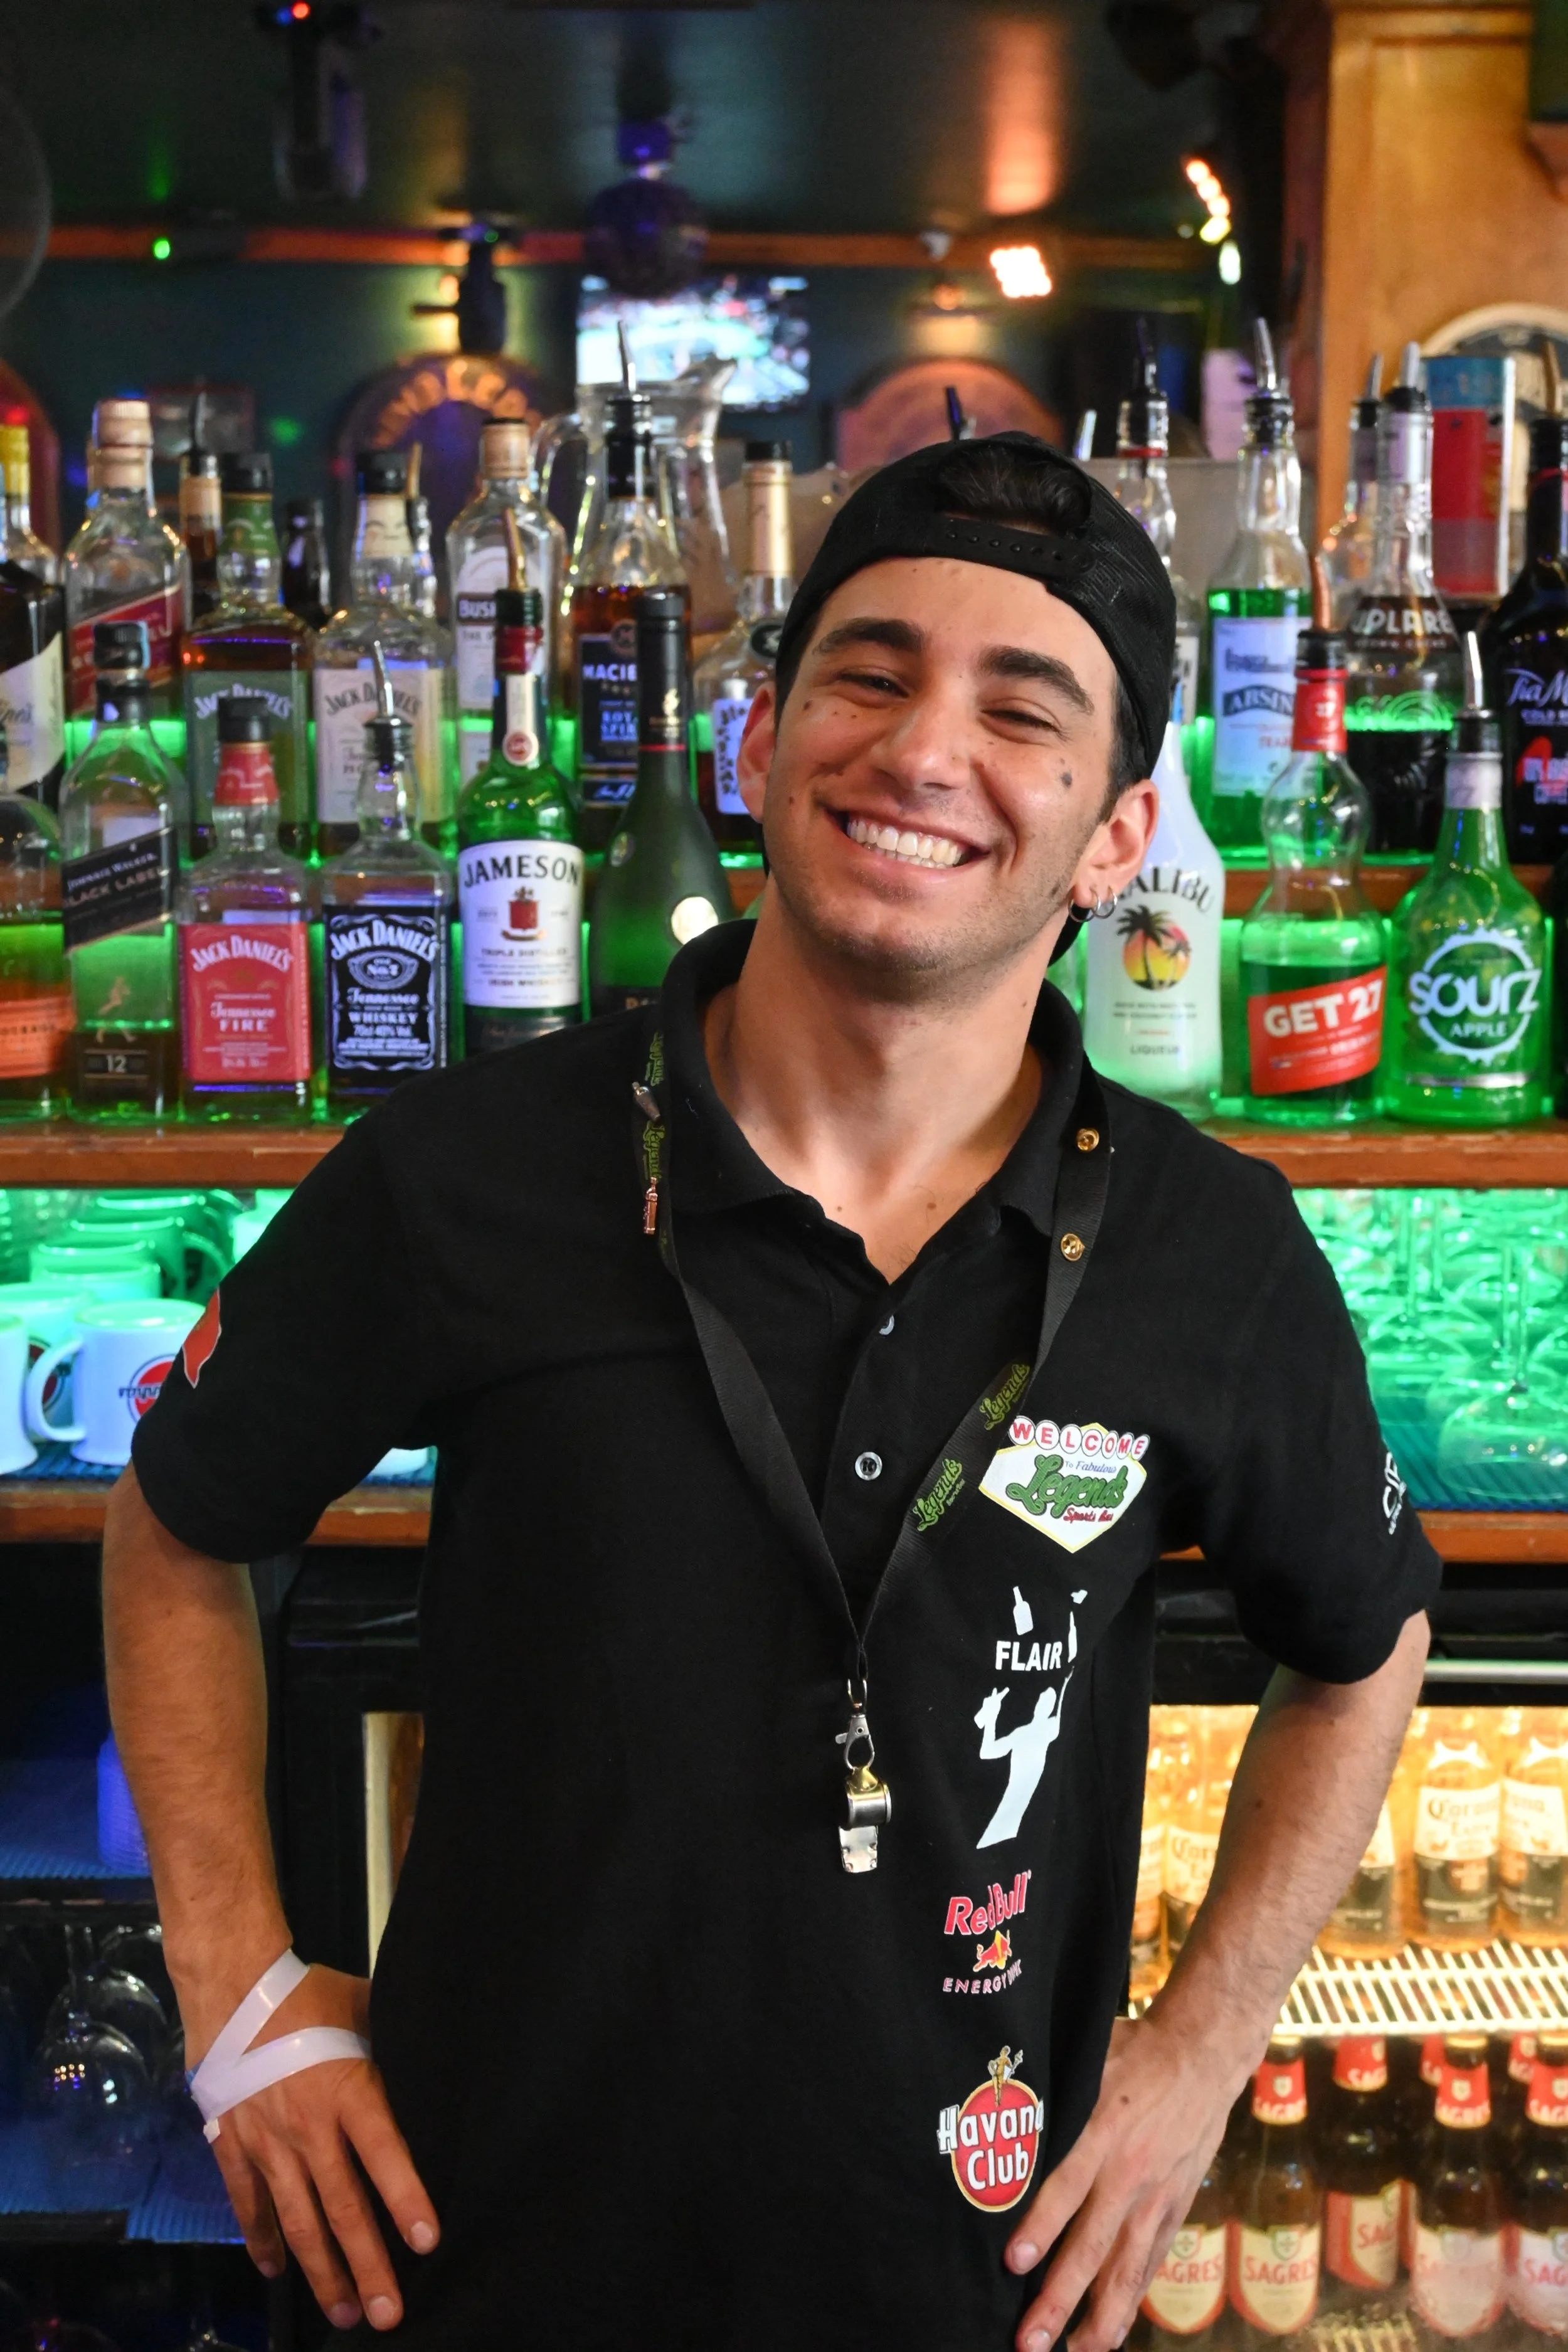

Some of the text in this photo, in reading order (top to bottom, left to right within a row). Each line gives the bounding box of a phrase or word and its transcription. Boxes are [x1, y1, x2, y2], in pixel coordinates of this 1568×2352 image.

[464, 855, 580, 889] JAMESON
[1116, 866, 1215, 914] ALIBU
[190, 934, 294, 972] JACK DANIEL'S
[330, 919, 441, 962] JACK DANIEL'S
[219, 1018, 268, 1032] FIRE
[348, 1012, 418, 1024] WHISKEY
[1263, 978, 1383, 1038] GET 27
[1449, 1021, 1507, 1037] APPLE
[106, 1055, 128, 1073] 12
[979, 1364, 1030, 1431] Legends
[1012, 1422, 1145, 1454] WELCOME
[912, 1458, 963, 1532] Legends
[1005, 1454, 1129, 1519] Legends
[995, 1641, 1064, 1671] FLAIR
[943, 1973, 1007, 1994] ENERGY
[966, 2143, 1030, 2191] Club
[1158, 2253, 1224, 2284] AGRES
